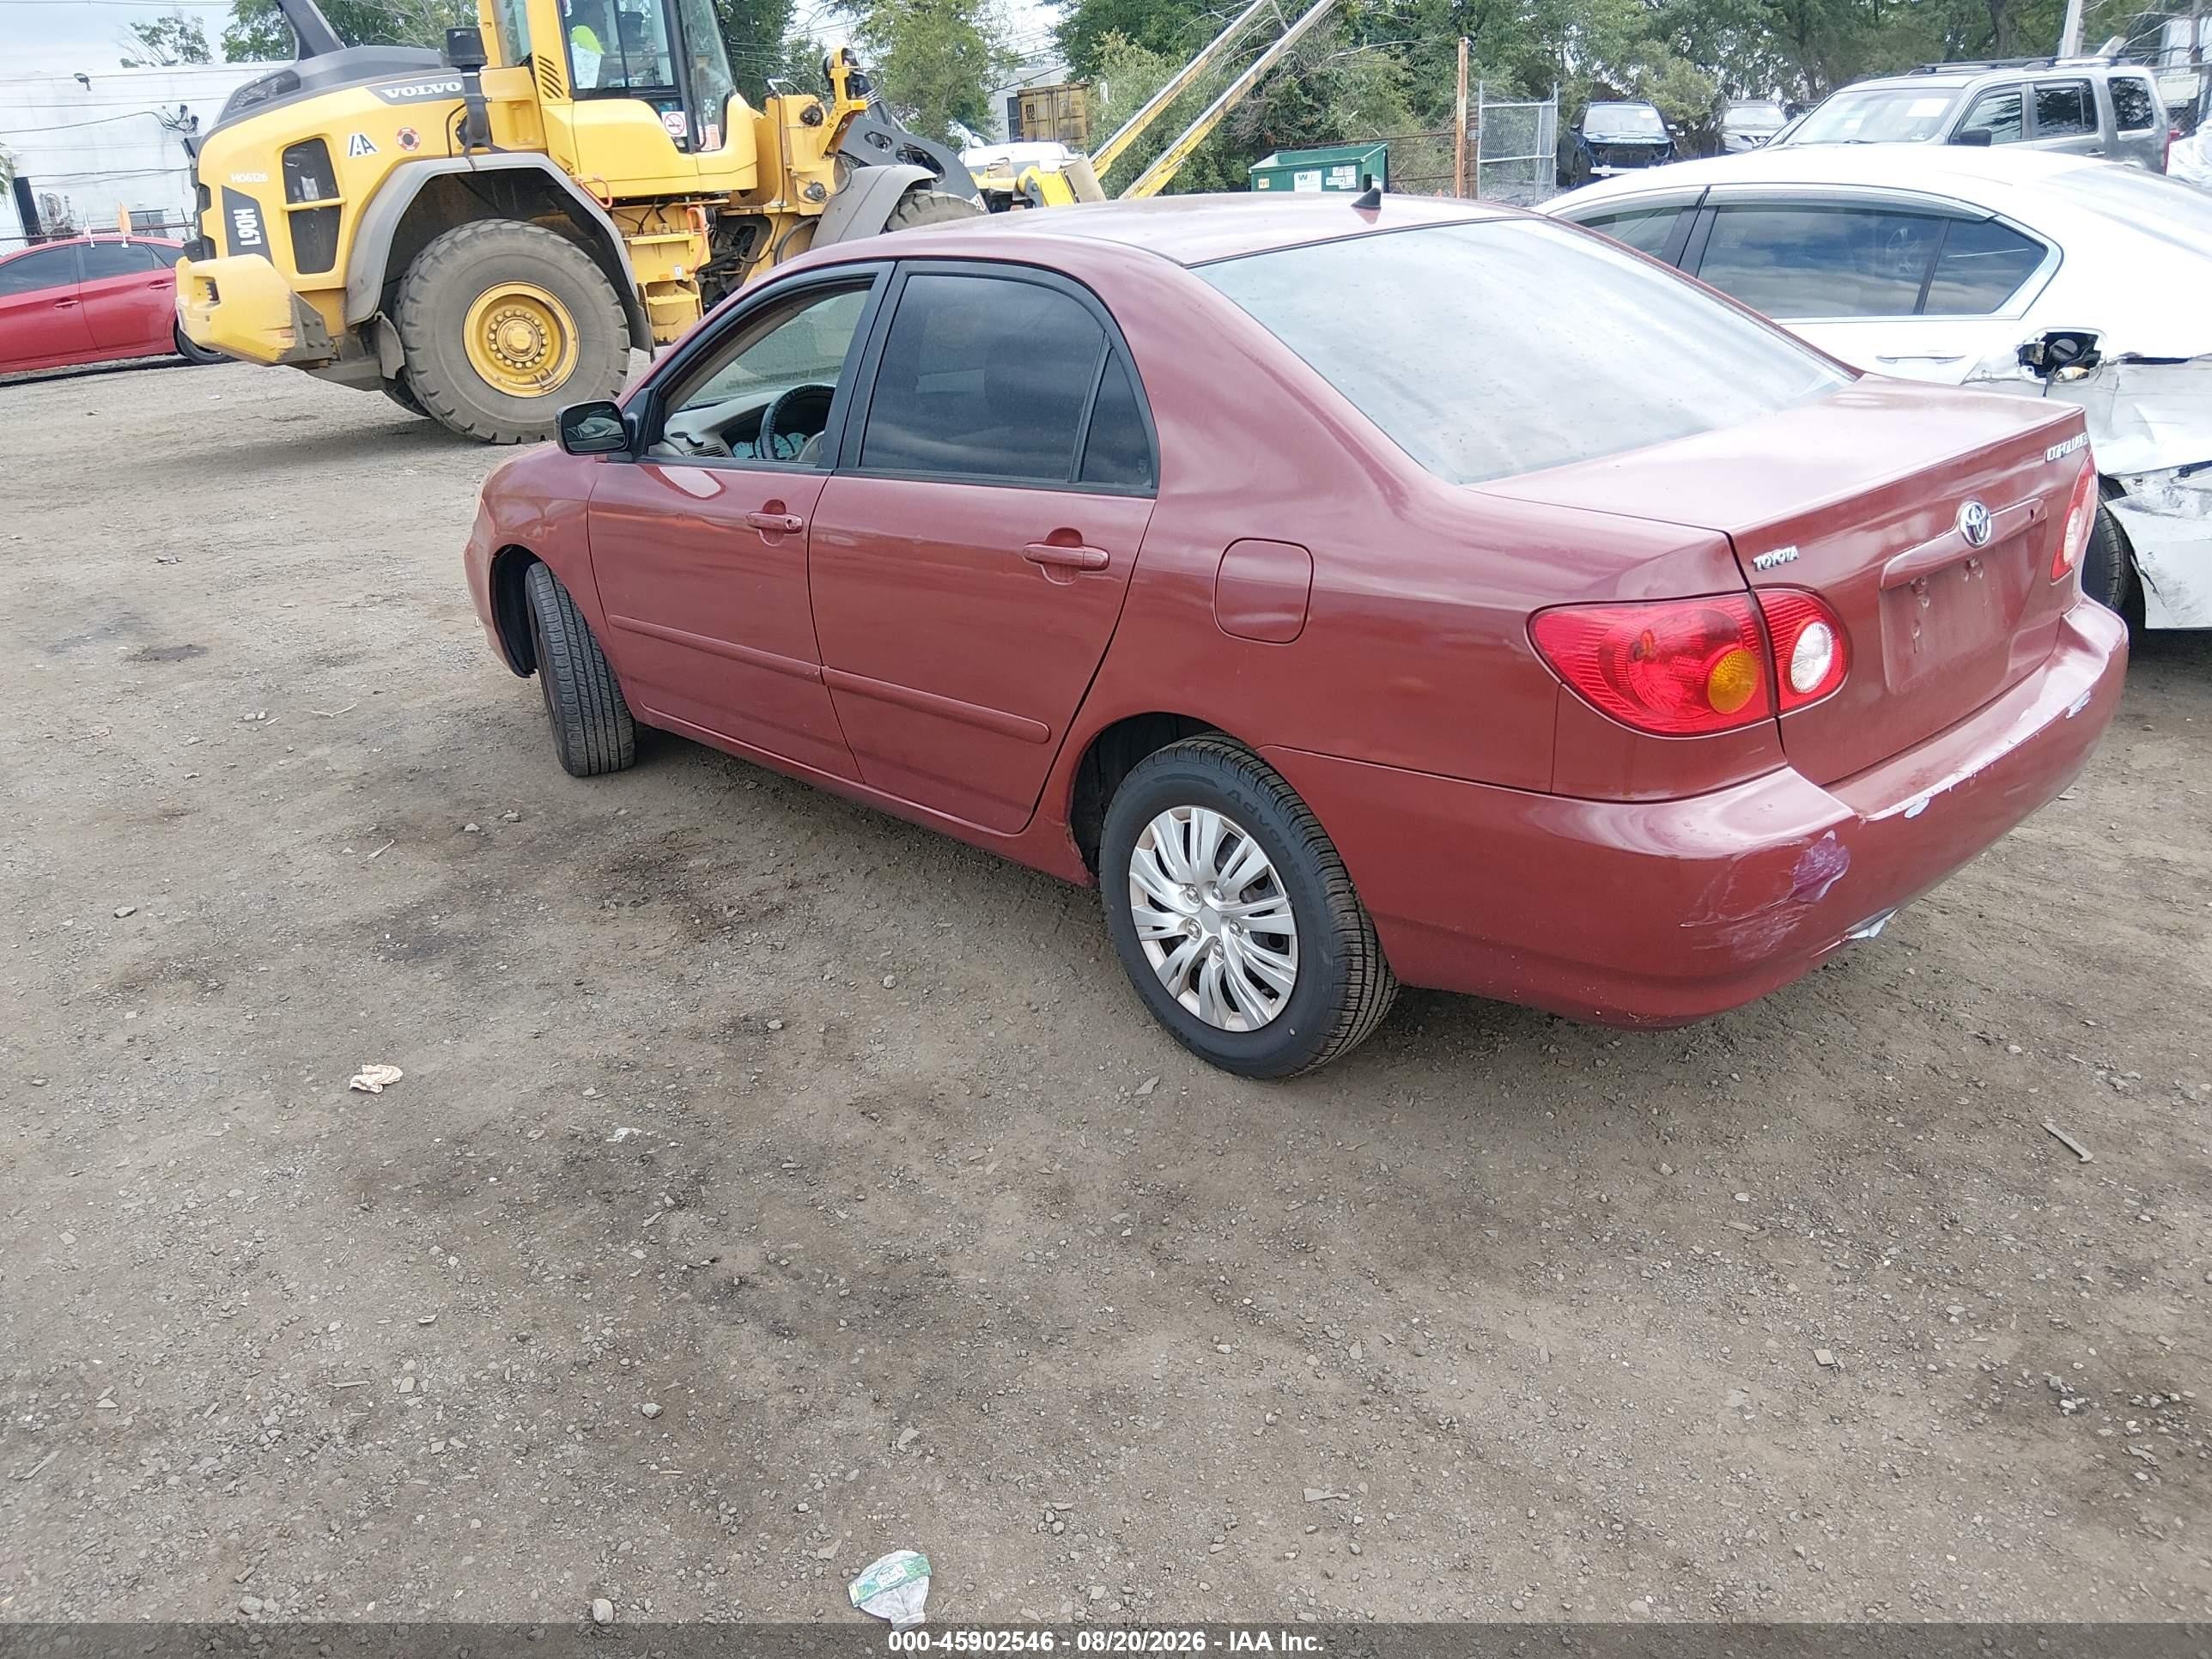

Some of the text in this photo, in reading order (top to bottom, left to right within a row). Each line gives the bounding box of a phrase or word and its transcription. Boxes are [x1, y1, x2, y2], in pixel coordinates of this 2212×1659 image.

[381, 82, 462, 98] VOLVO
[233, 208, 262, 246] H061
[1753, 545, 1799, 571] TOYOTA
